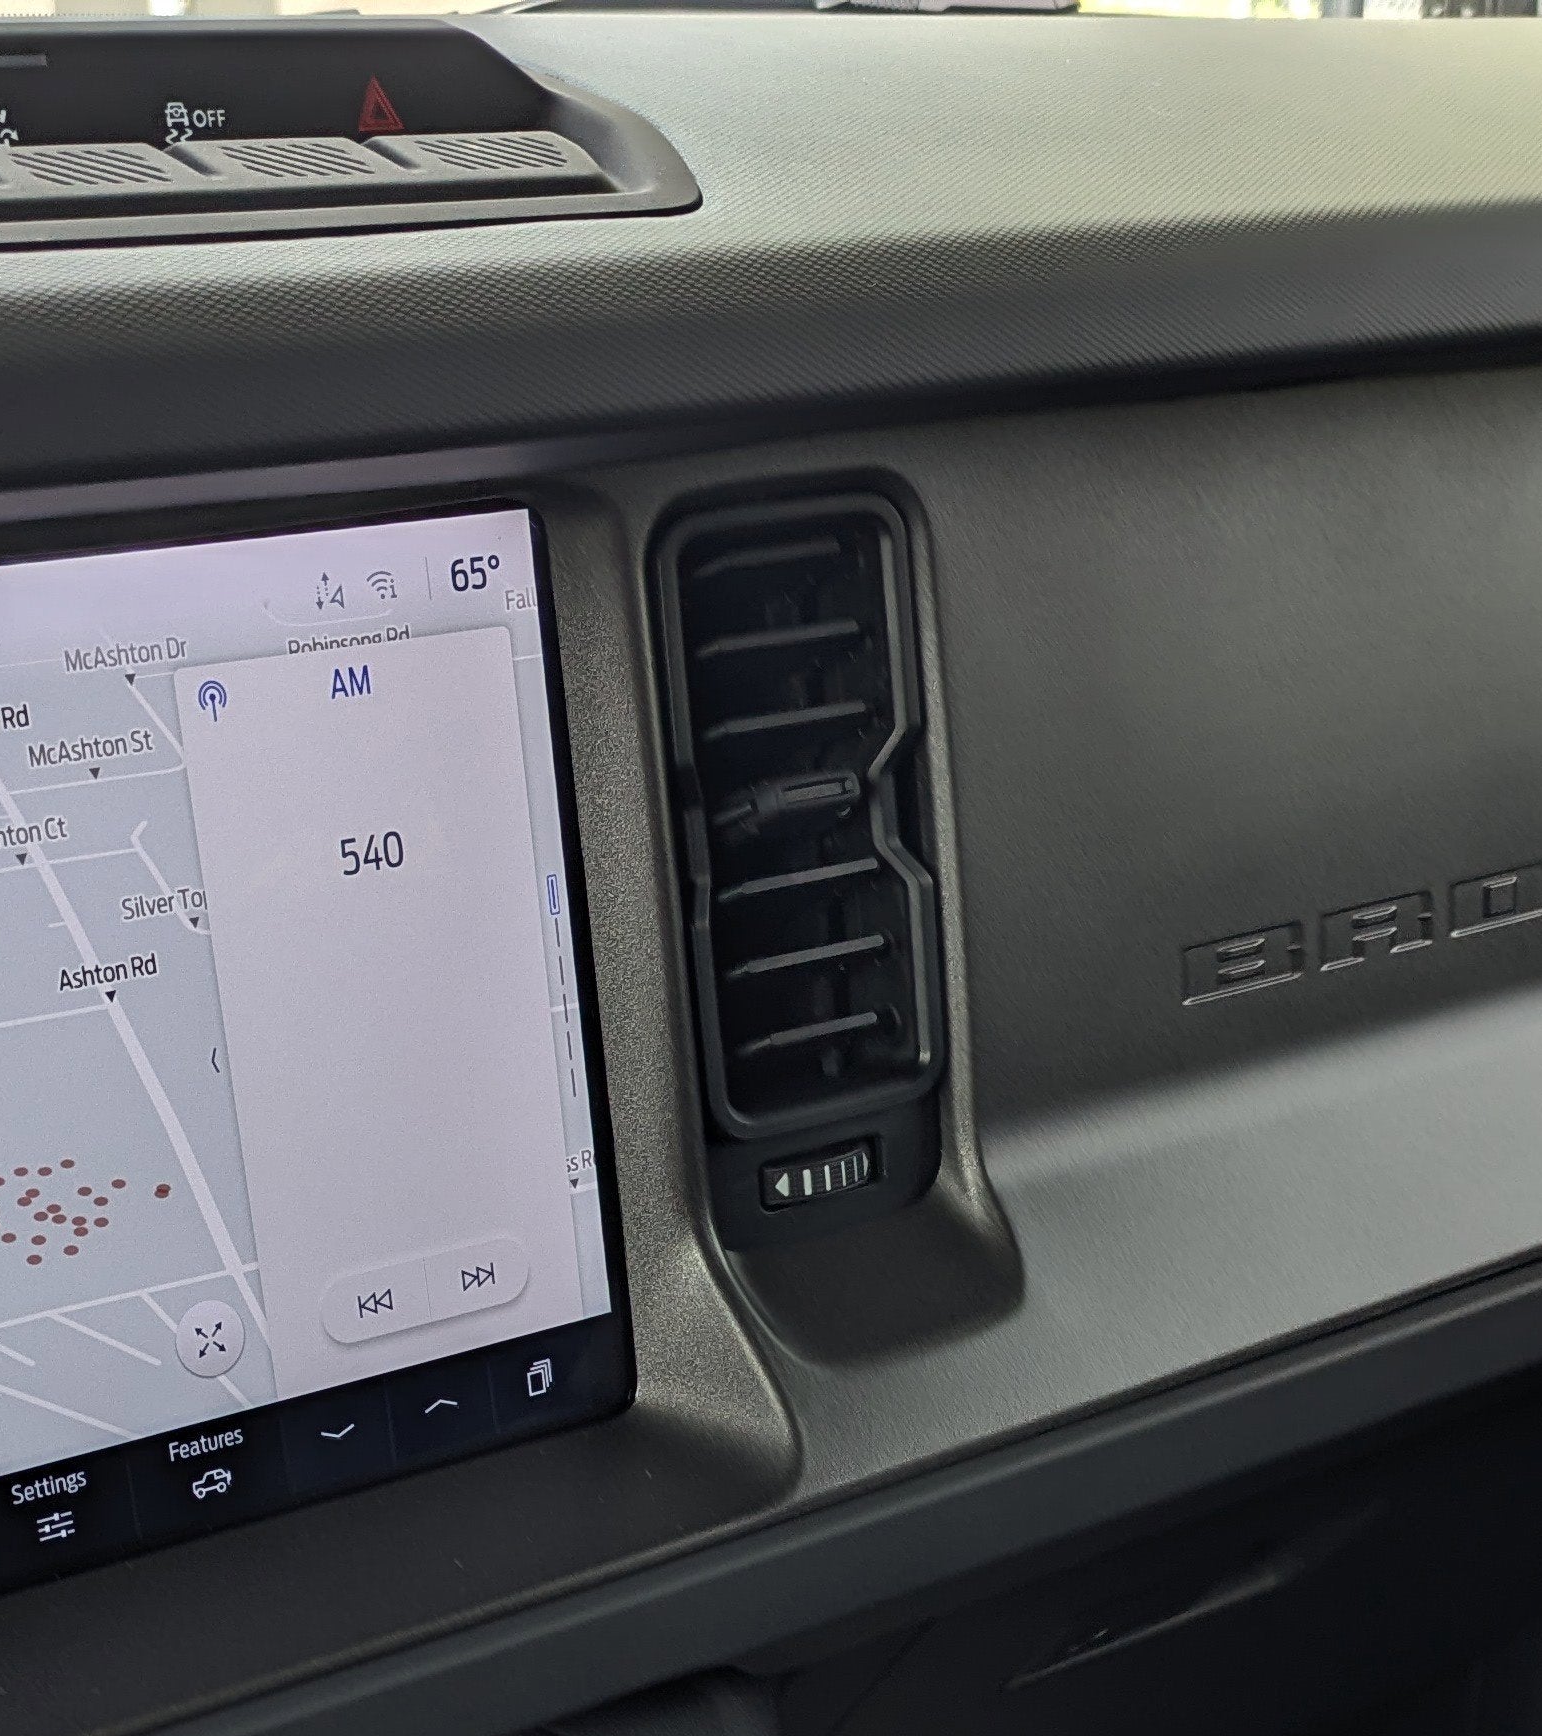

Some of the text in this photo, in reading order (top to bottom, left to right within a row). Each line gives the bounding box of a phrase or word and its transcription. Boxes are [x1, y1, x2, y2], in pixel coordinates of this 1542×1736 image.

[192, 110, 227, 128] OFF
[449, 554, 501, 594] 65°
[63, 636, 188, 674] McAshton Dr
[331, 664, 372, 700] AM
[0, 703, 30, 730] Rd
[27, 729, 154, 770] McAshton St
[42, 816, 68, 842] Ct
[340, 831, 405, 877] 540
[121, 895, 175, 921] Silver
[57, 953, 158, 993] Ashton Rd
[167, 1426, 244, 1461] Features
[10, 1468, 88, 1507] Settings
